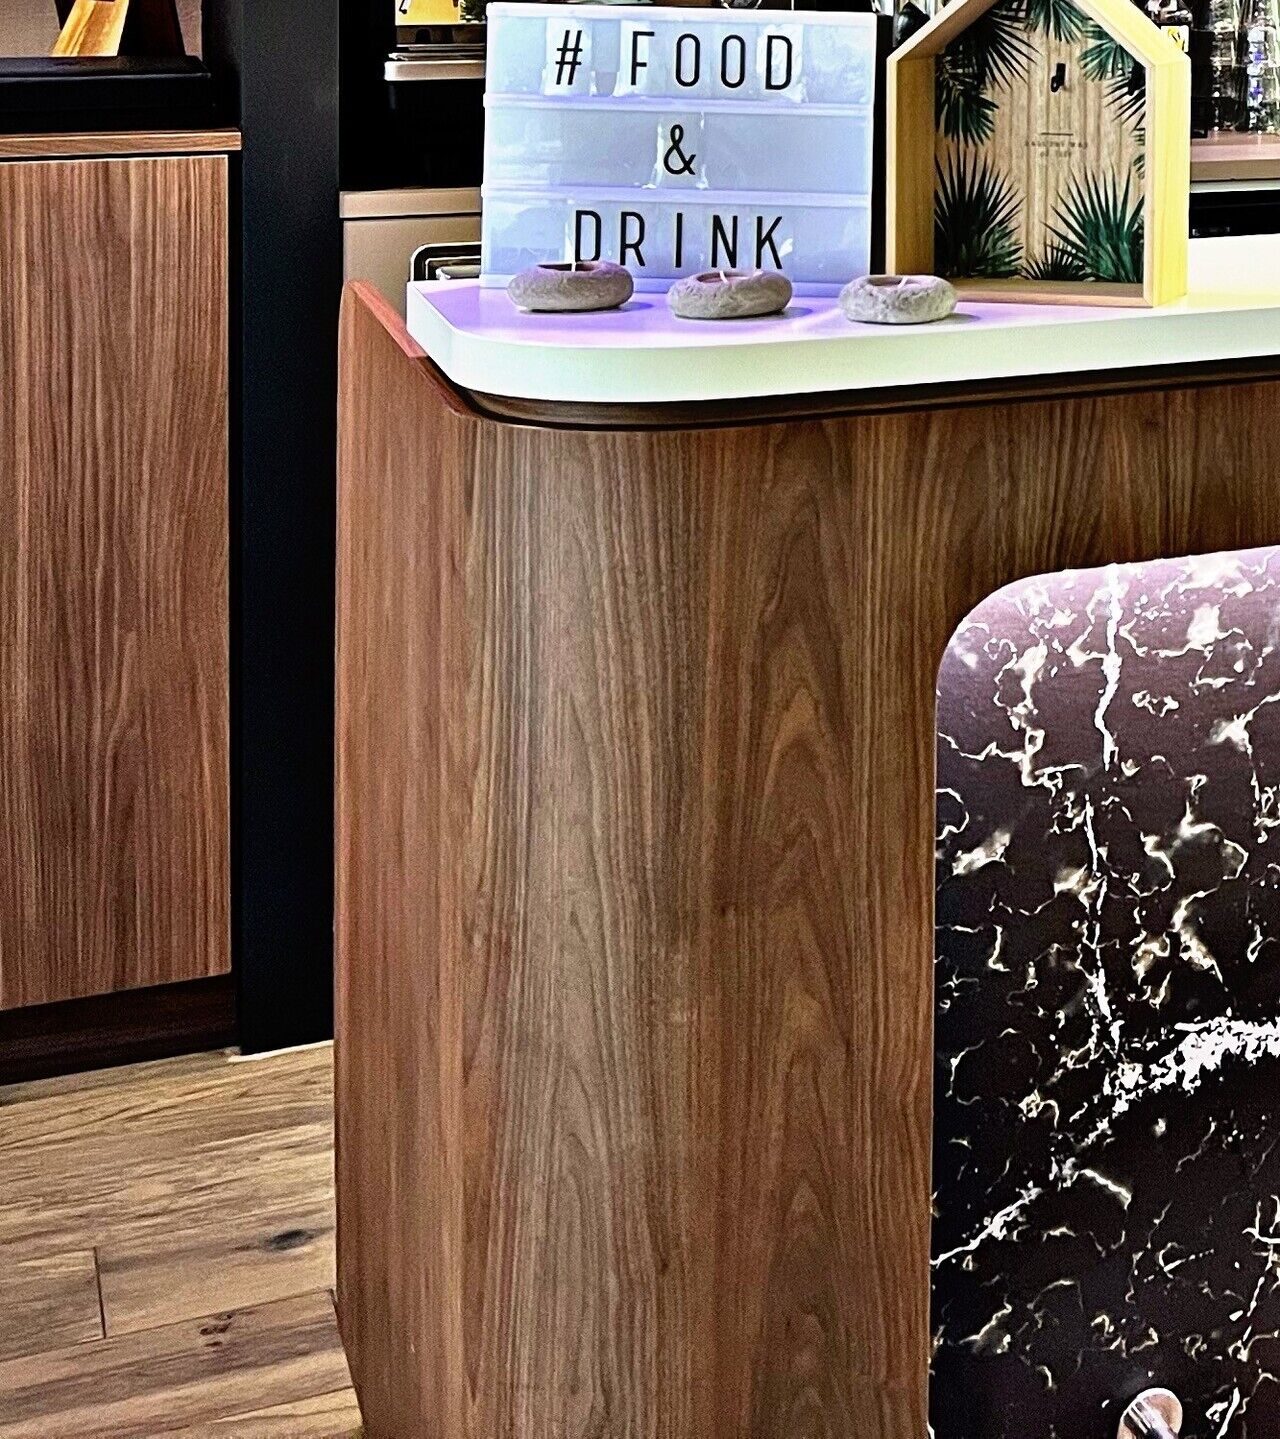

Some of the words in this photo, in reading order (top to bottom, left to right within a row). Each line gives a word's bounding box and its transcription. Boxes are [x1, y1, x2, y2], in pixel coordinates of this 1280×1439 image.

[554, 28, 583, 87] #
[629, 30, 794, 92] FOOD
[662, 123, 697, 176] &
[573, 209, 784, 271] DRINK
